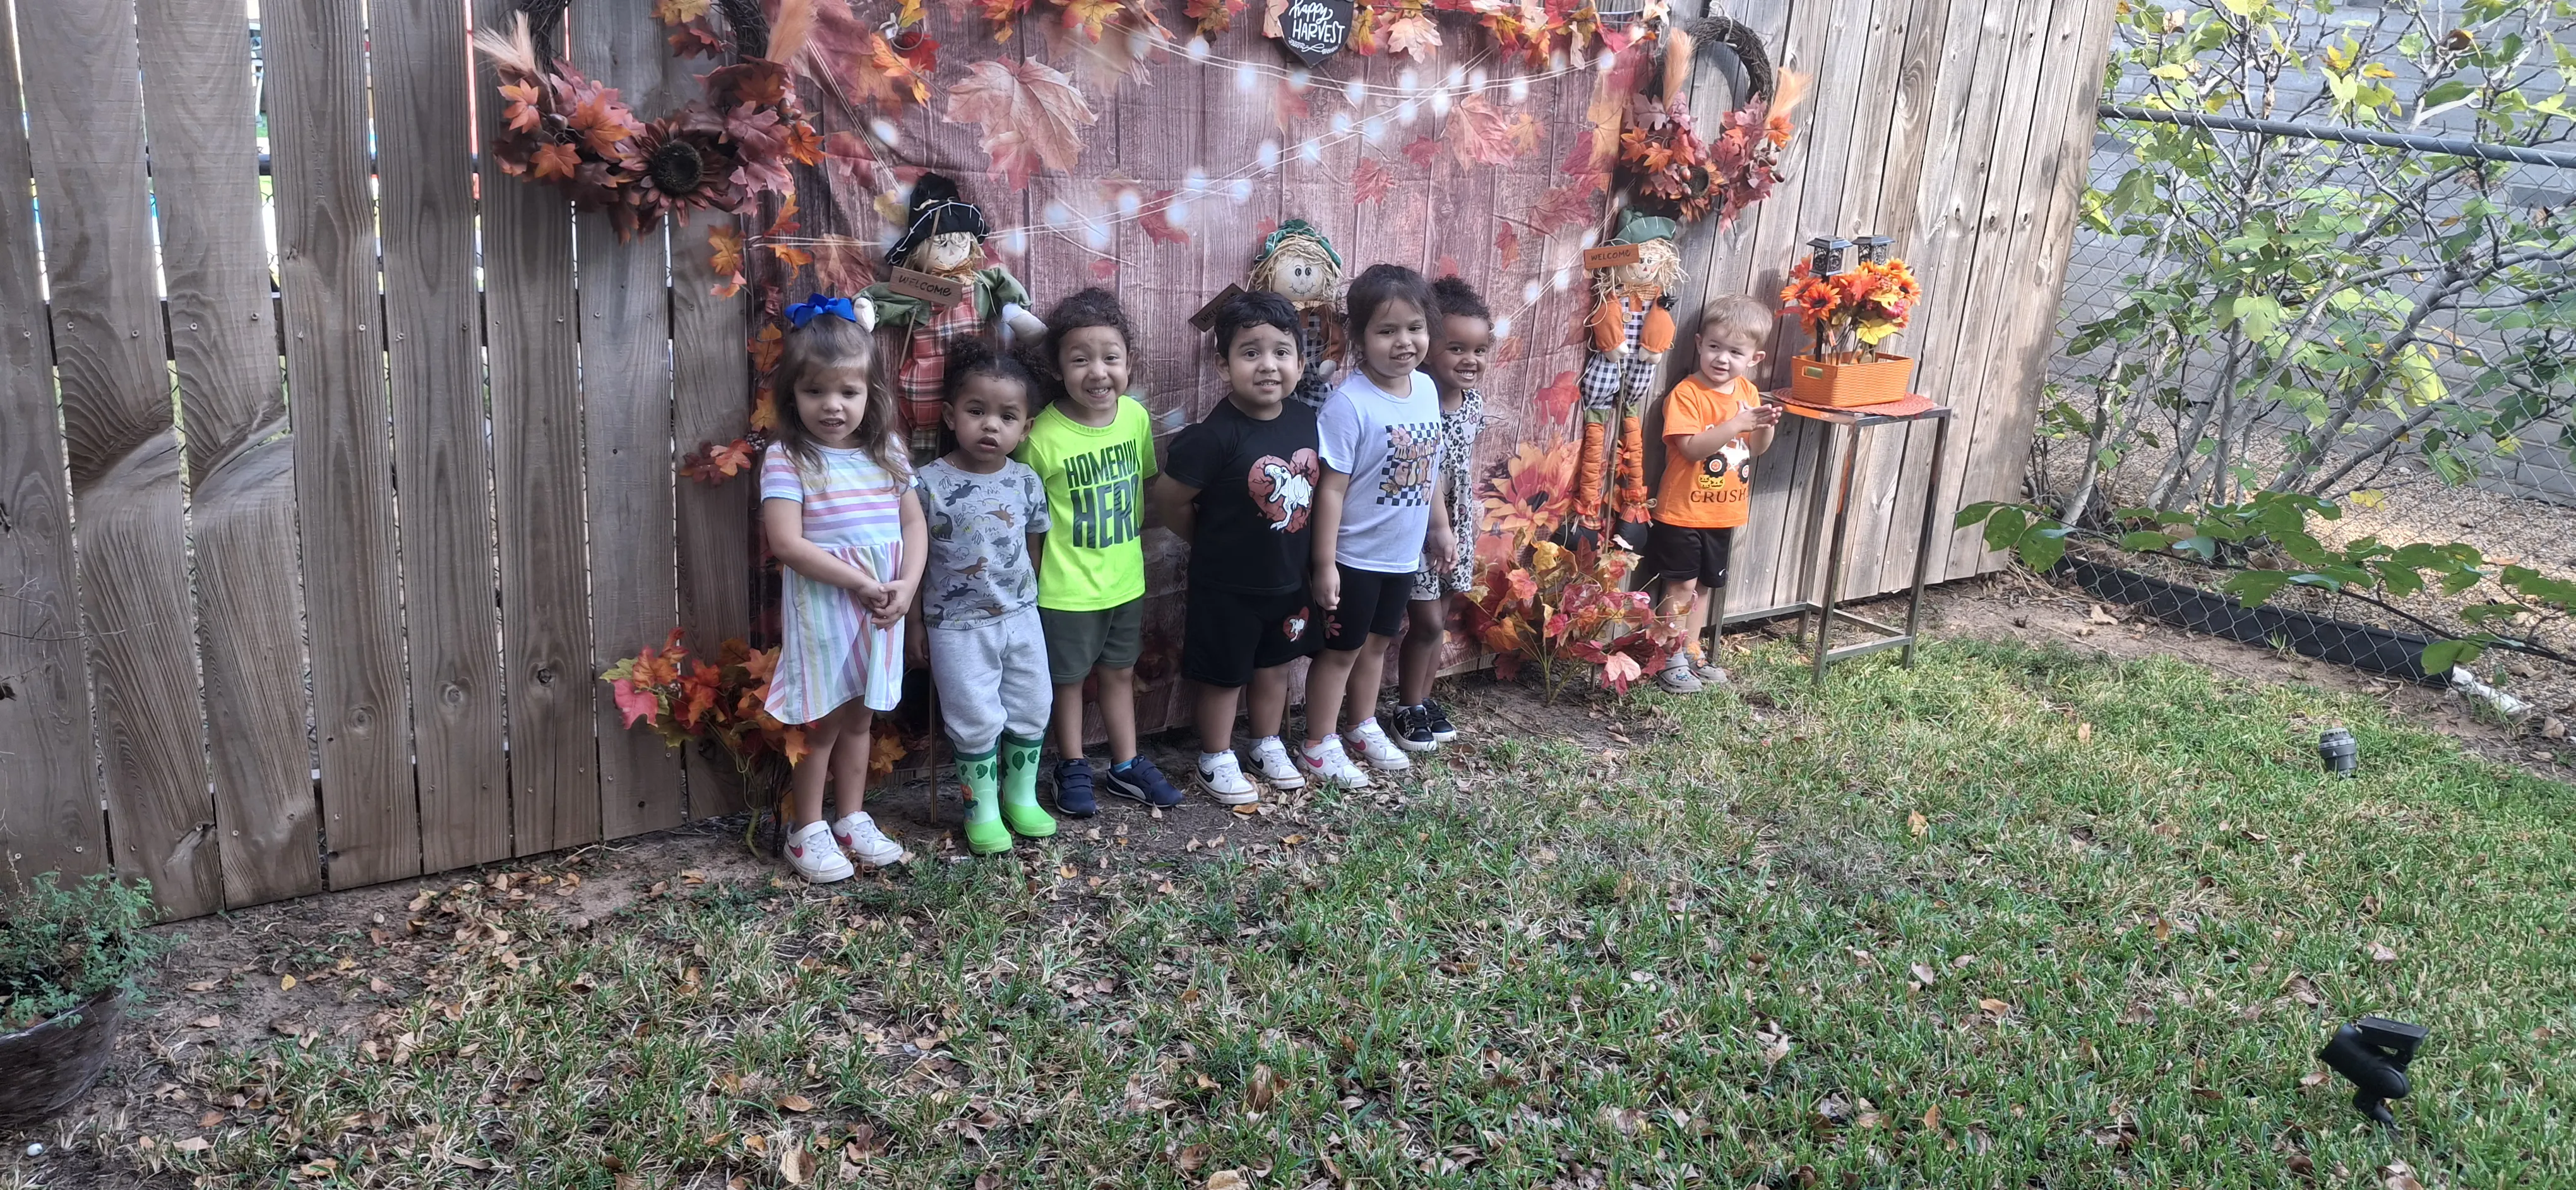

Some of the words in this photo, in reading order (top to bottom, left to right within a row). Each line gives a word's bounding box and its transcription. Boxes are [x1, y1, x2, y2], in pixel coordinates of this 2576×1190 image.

[1292, 18, 1345, 44] HARVEST
[1590, 249, 1631, 261] WELCOME
[898, 275, 952, 297] WELCOME
[1200, 292, 1238, 323] WELC
[1063, 438, 1141, 489] HOMERUN
[1070, 474, 1140, 550] HERO
